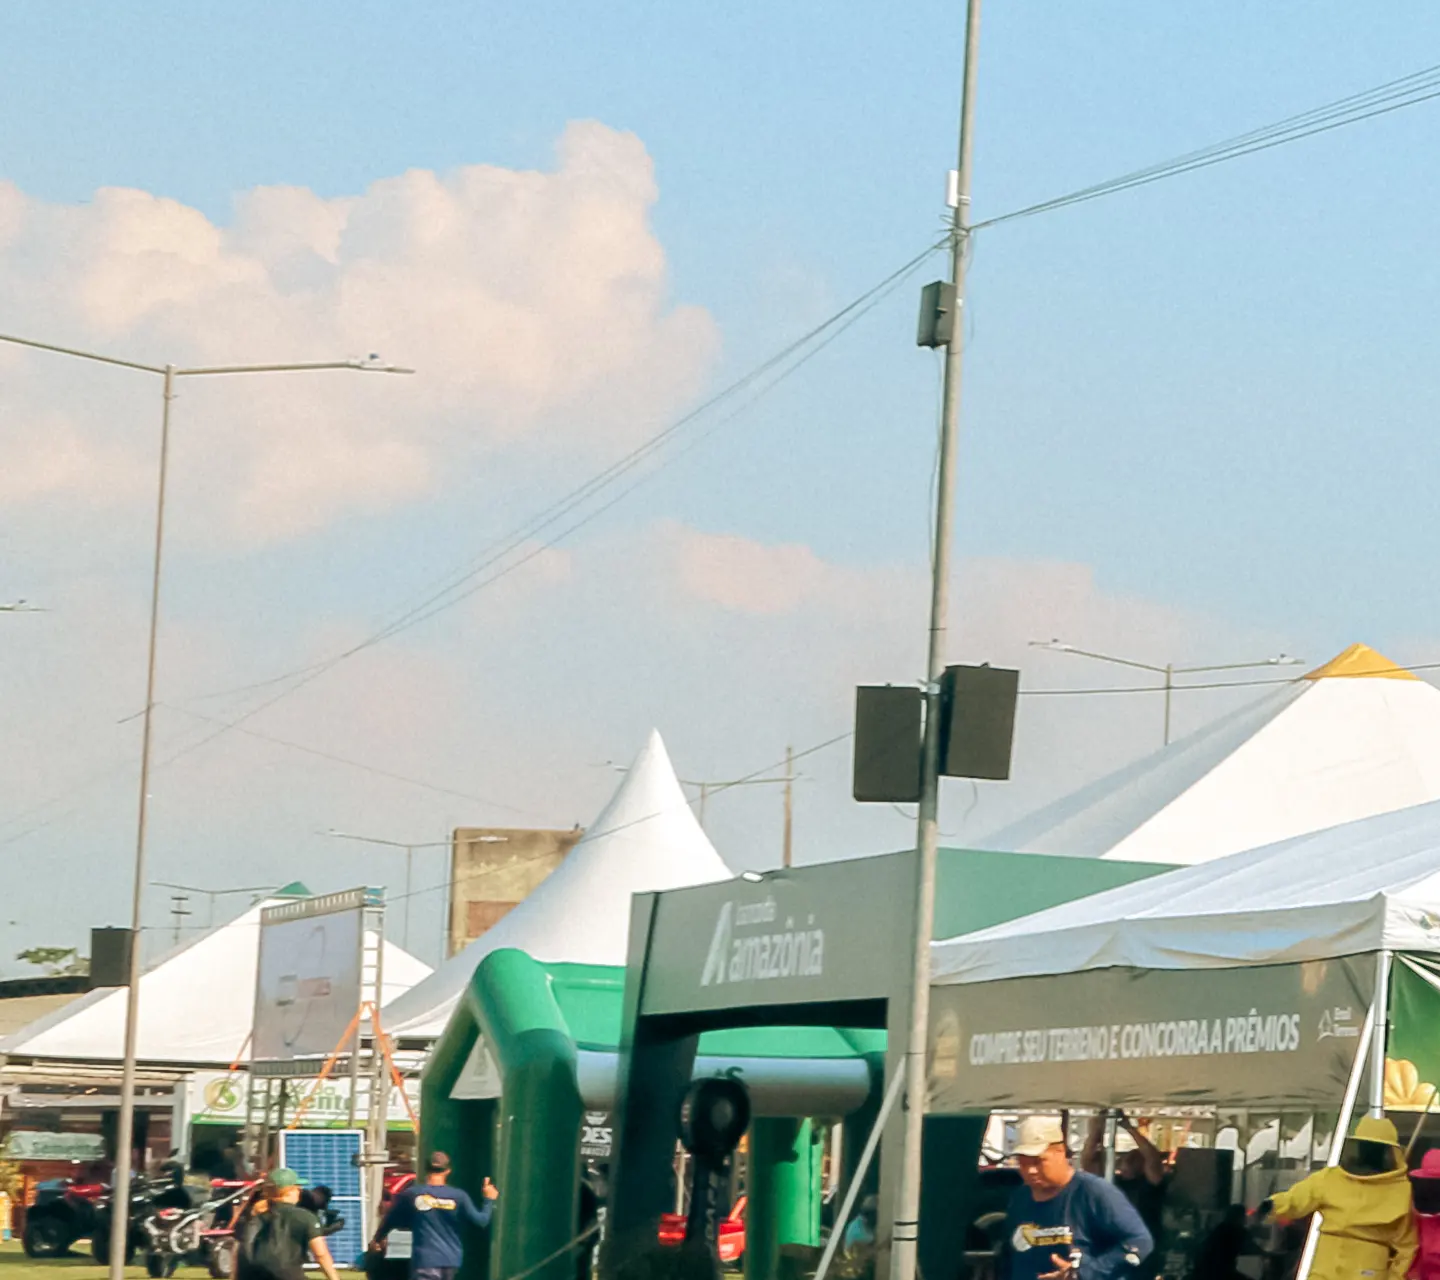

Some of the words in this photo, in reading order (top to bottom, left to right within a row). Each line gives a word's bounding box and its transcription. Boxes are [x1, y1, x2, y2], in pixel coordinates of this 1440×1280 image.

[729, 914, 824, 982] amazônia
[970, 1030, 1023, 1066] COMPRE
[1023, 1030, 1044, 1063] SEU
[1045, 1025, 1108, 1062] TERRENO
[1109, 1024, 1121, 1060] E
[1121, 1019, 1207, 1059] CONCORRA
[1206, 1018, 1223, 1056] A
[1224, 1007, 1300, 1054] PRÊMIOS
